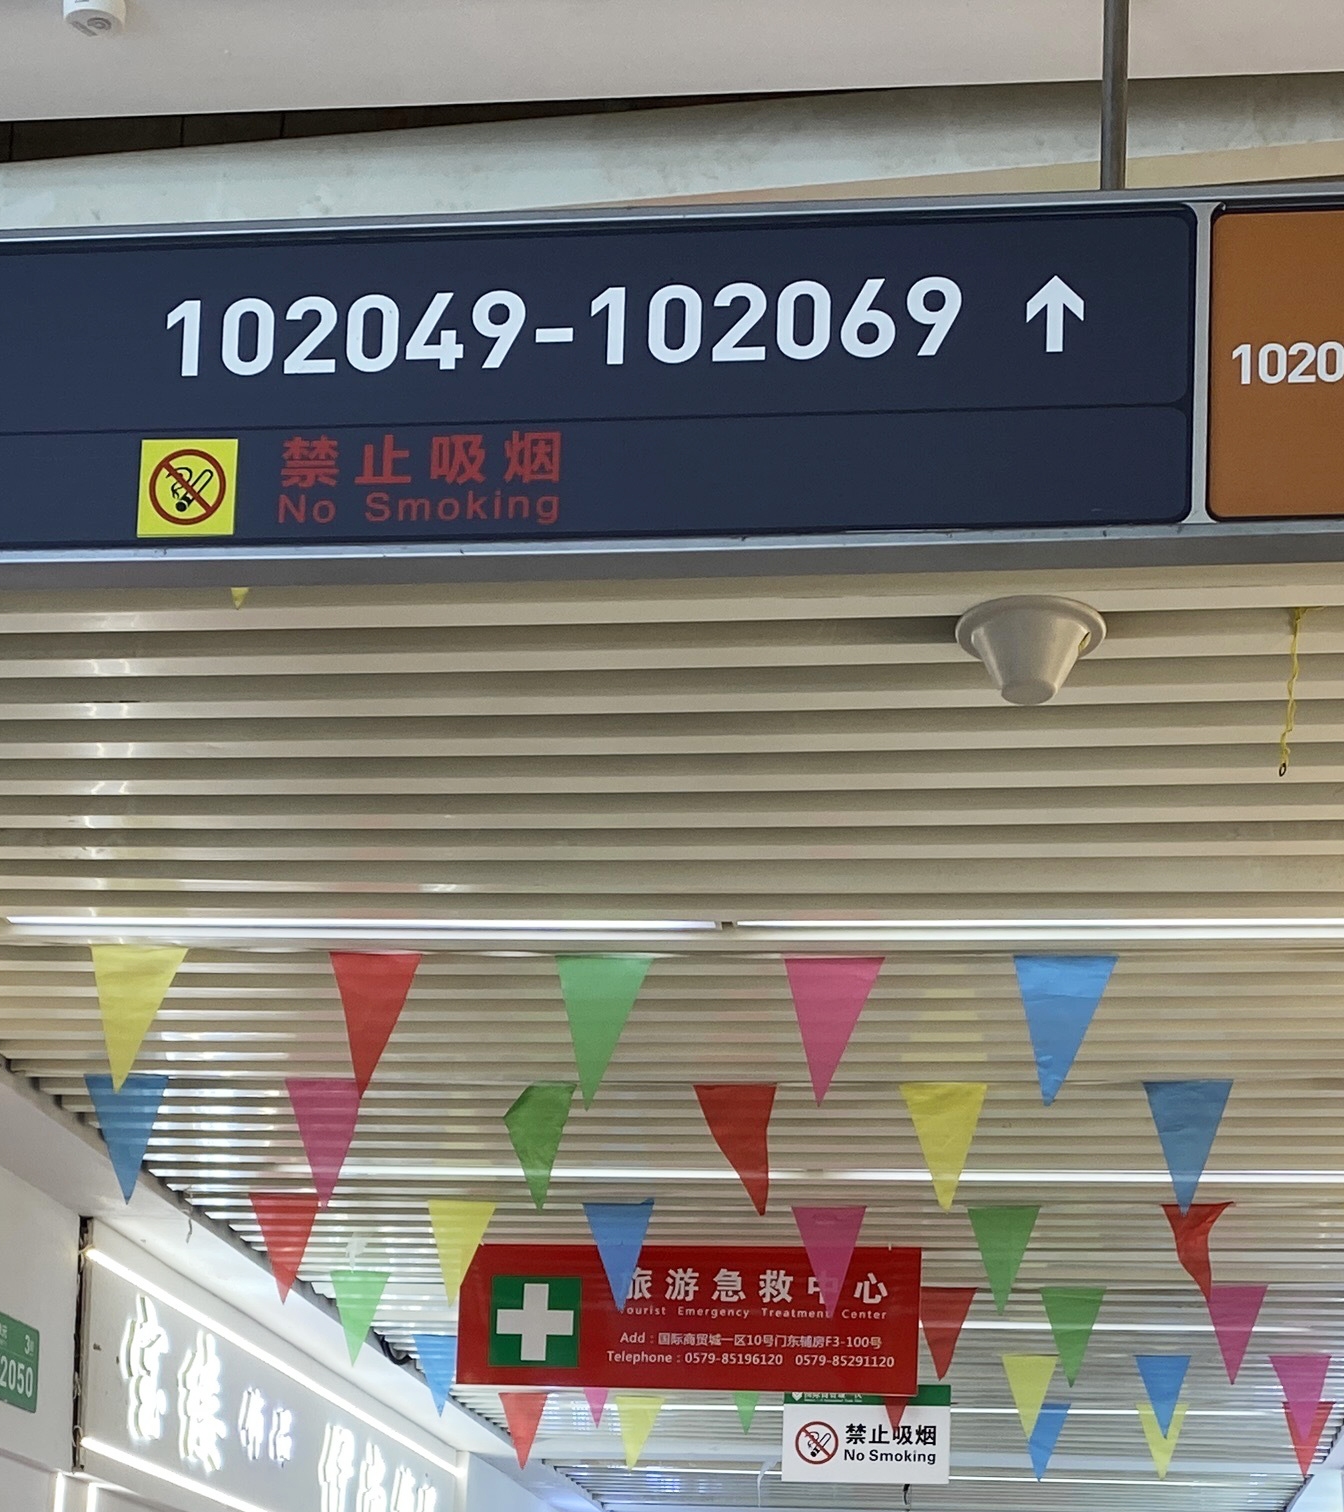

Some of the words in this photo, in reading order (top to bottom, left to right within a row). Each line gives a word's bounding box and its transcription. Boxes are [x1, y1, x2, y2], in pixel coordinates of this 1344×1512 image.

[166, 276, 962, 378] 102049-102069
[280, 430, 562, 489] 禁止吸烟
[277, 492, 337, 525] No
[364, 490, 562, 525] Smoking
[620, 1306, 667, 1317] ourist
[677, 1305, 750, 1320] Emergency
[841, 1308, 888, 1320] Center
[684, 1352, 784, 1366] 0579-85196120
[794, 1354, 896, 1368] 0579-85291120
[845, 1423, 937, 1446] 禁止吸烟
[843, 1449, 865, 1462] No
[868, 1449, 936, 1465] Smoking
